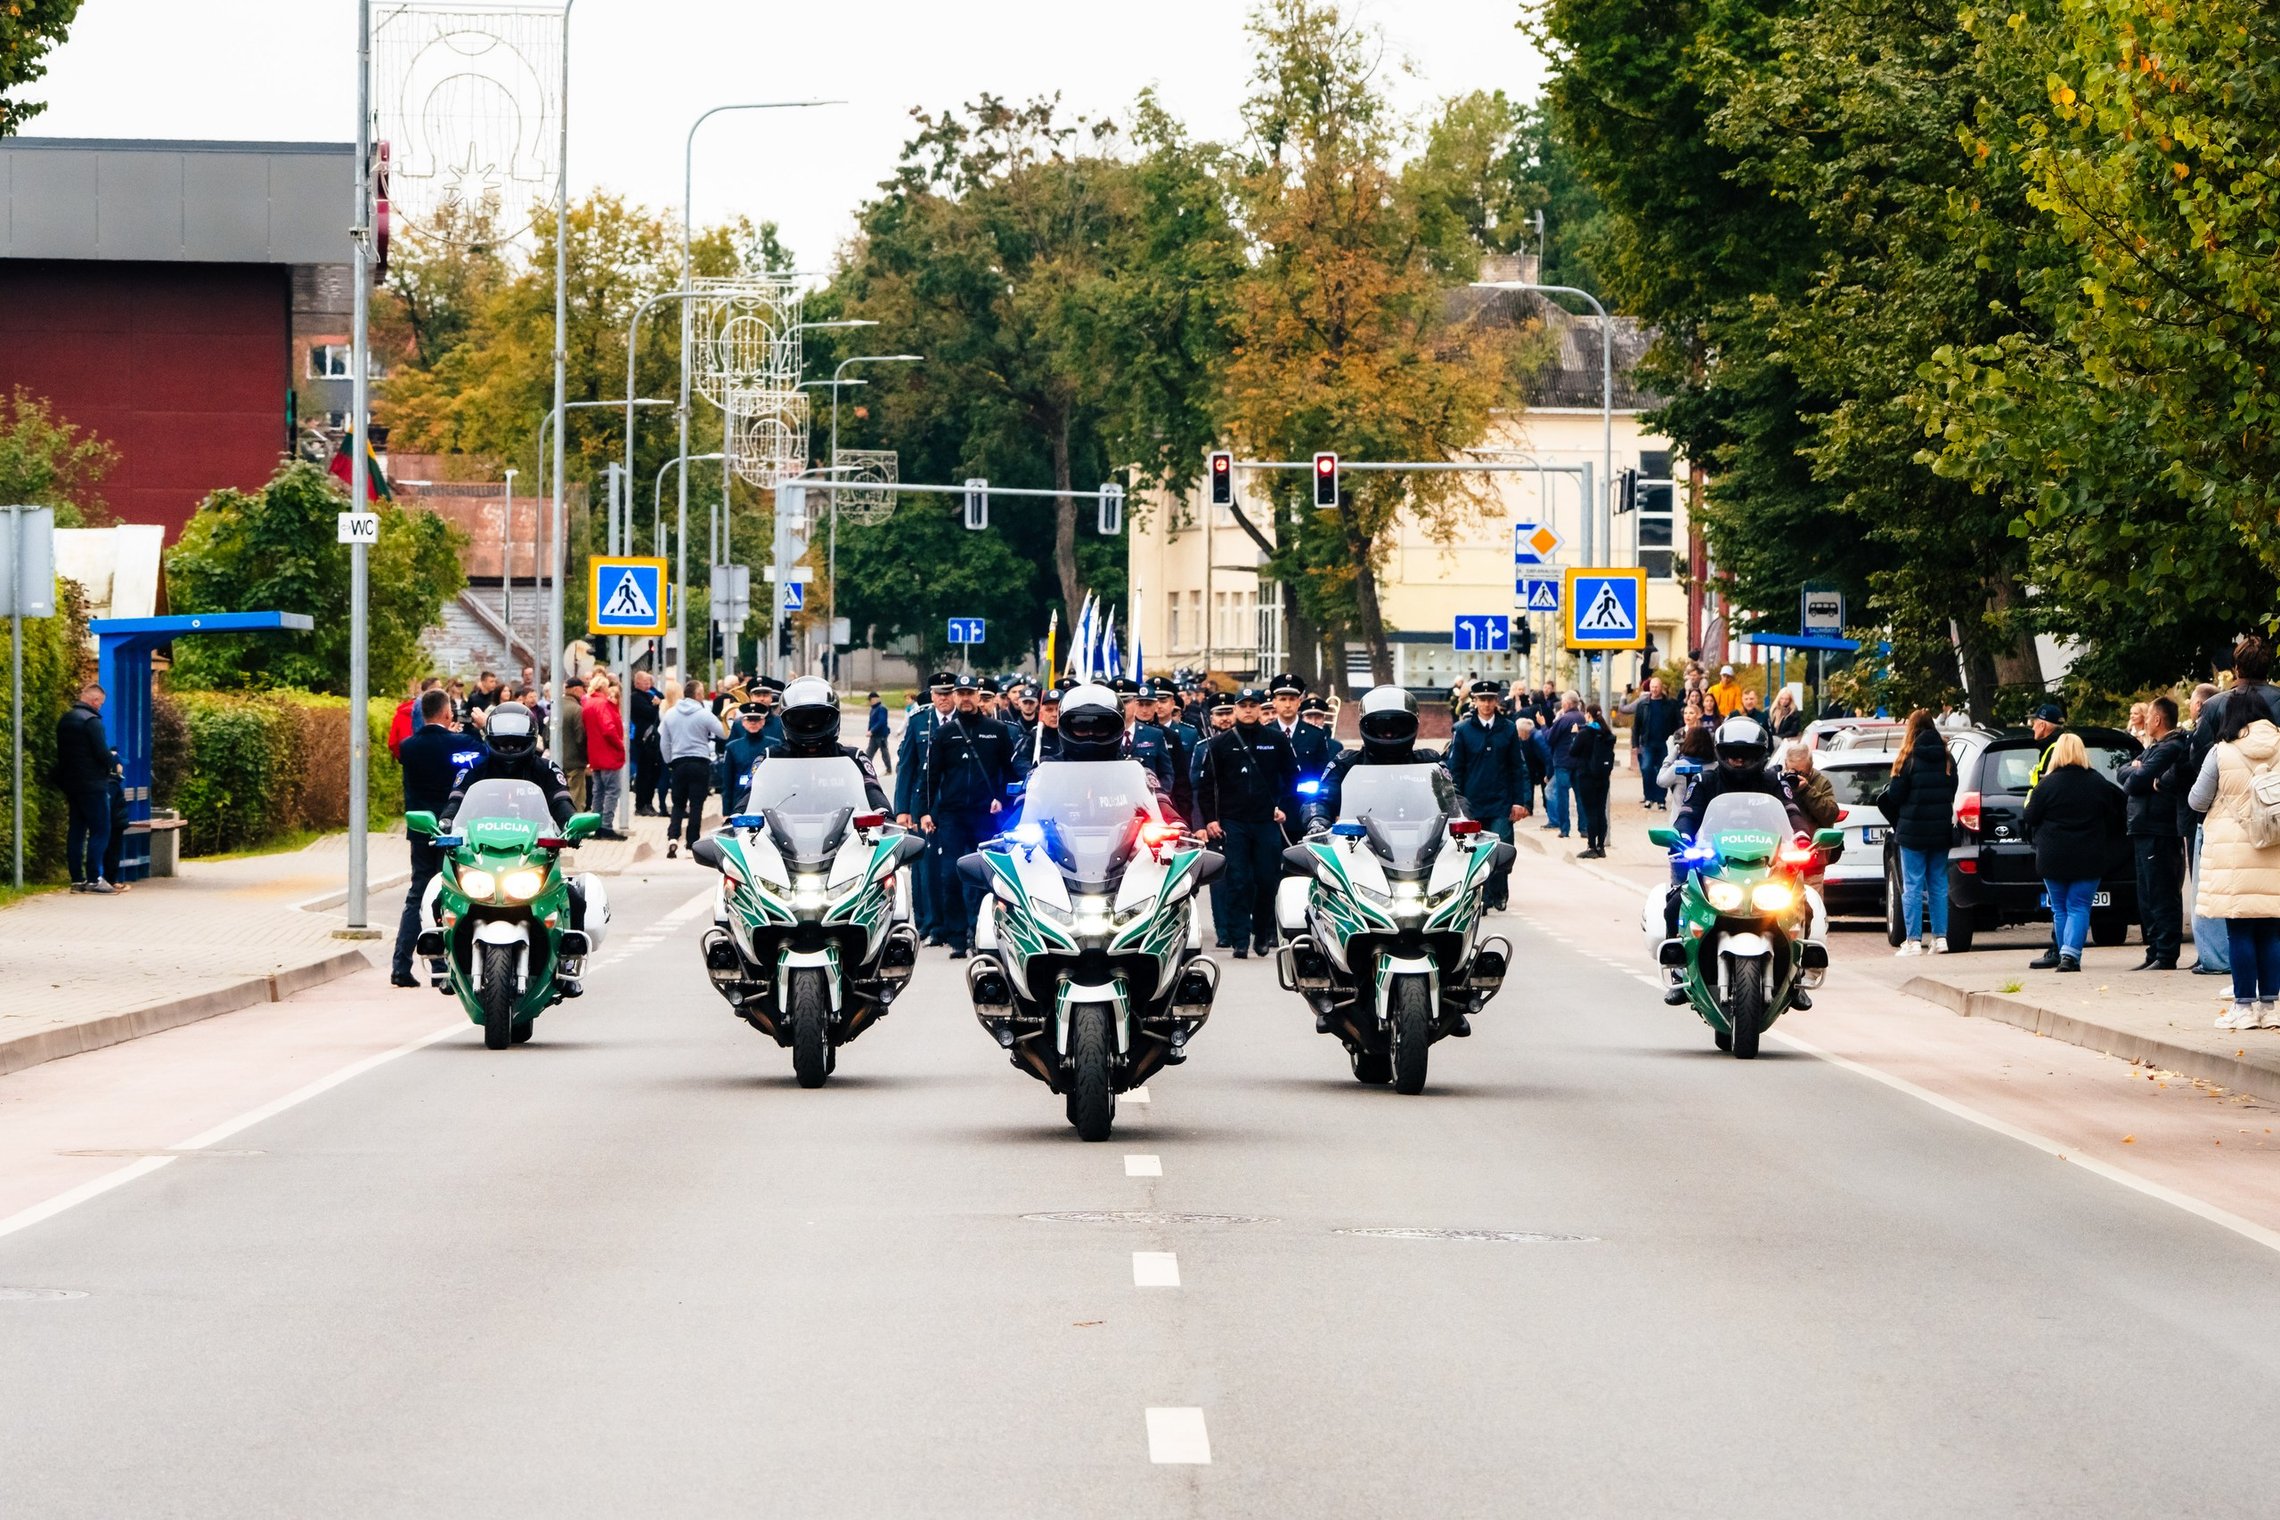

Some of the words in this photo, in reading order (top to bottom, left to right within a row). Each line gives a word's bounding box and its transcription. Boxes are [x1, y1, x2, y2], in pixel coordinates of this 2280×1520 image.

[351, 519, 373, 535] WC
[477, 822, 530, 833] POLICIJA
[1721, 834, 1773, 845] POLICIJA
